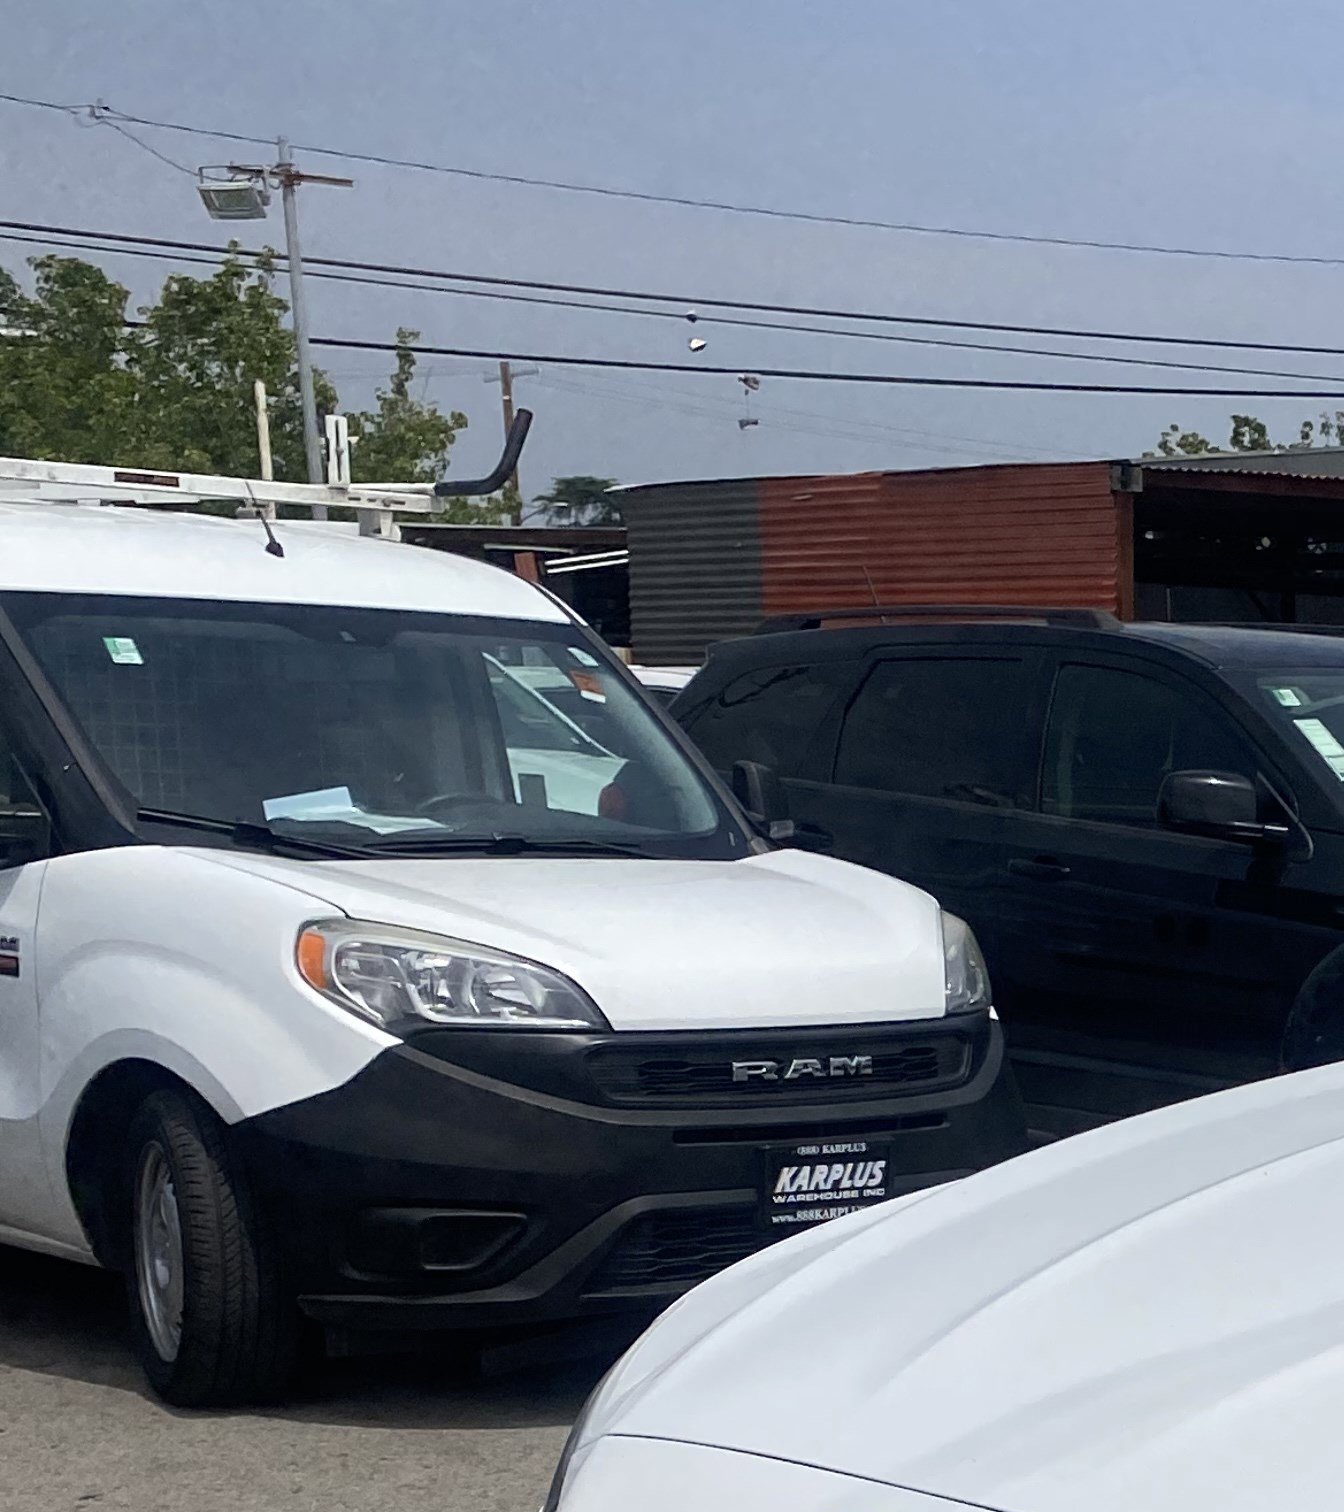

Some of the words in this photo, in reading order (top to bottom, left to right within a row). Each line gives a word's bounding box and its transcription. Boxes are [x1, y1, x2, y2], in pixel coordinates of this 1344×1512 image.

[732, 1055, 873, 1082] RAM
[822, 1142, 867, 1154] KARPLUS
[775, 1160, 887, 1193] KARPLUS
[772, 1189, 859, 1203] WAREHOUSE
